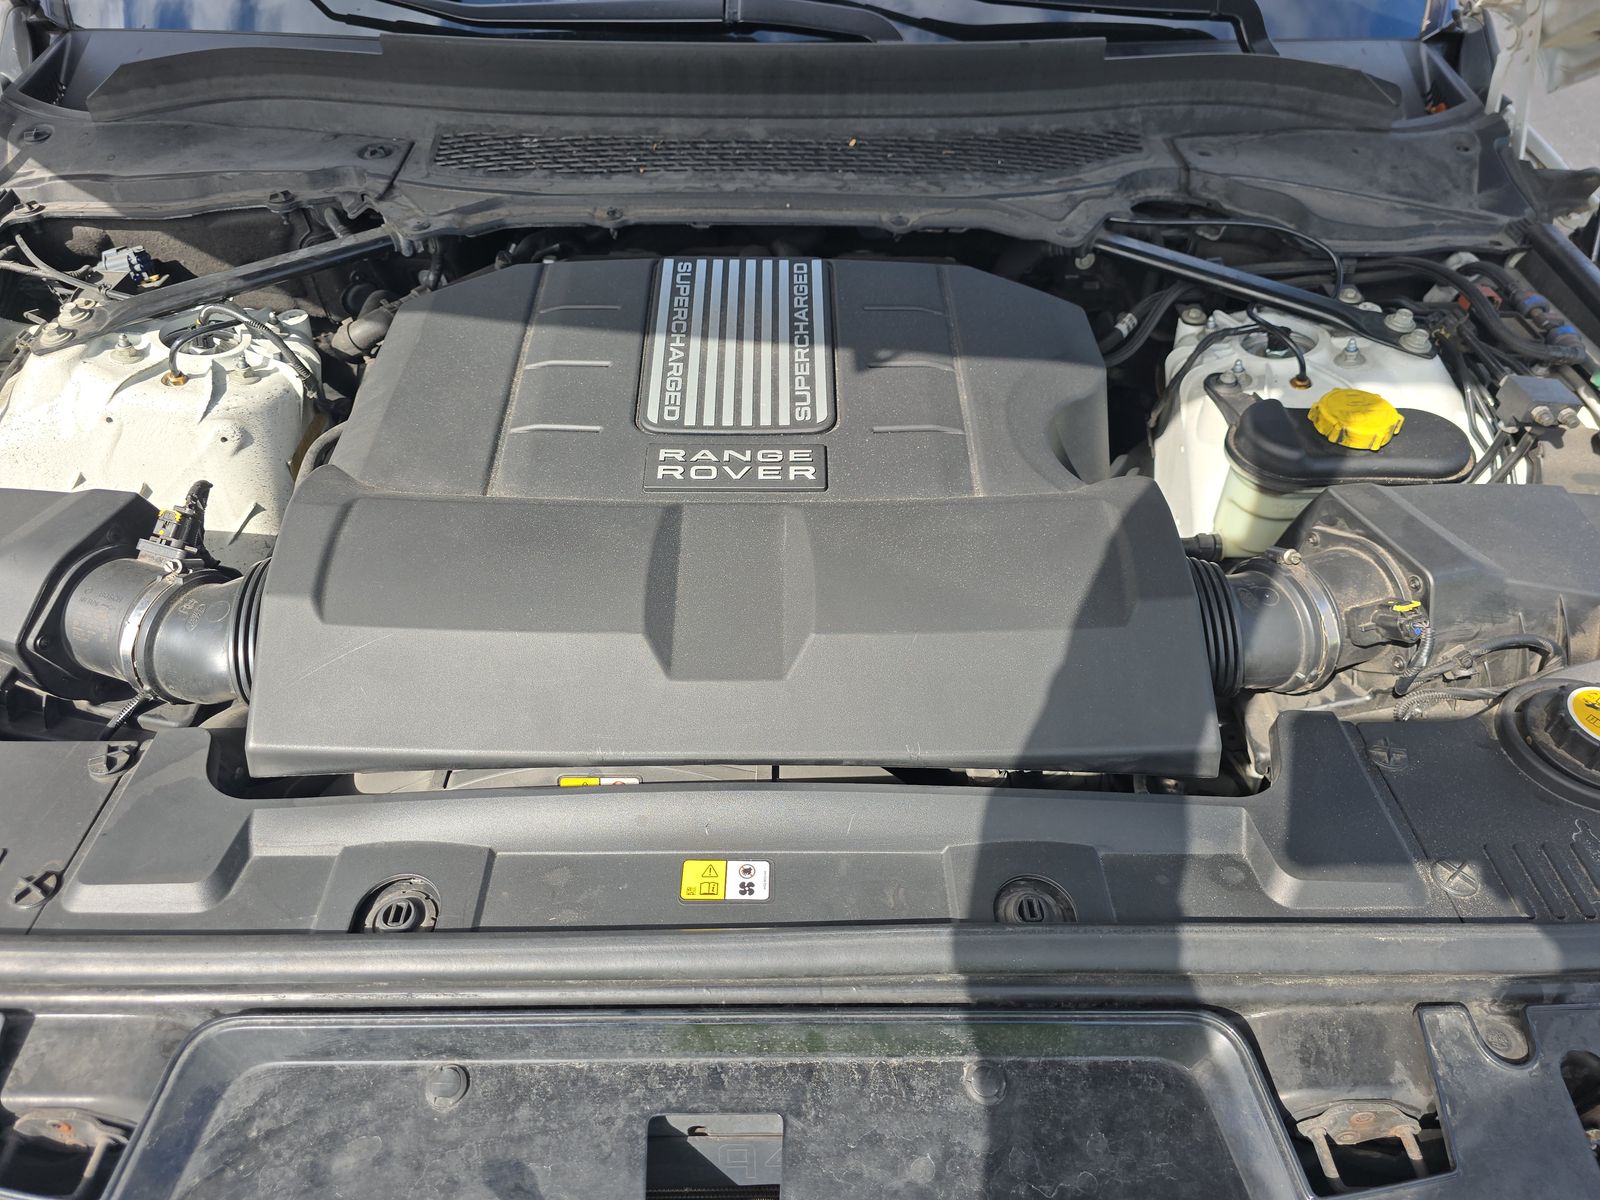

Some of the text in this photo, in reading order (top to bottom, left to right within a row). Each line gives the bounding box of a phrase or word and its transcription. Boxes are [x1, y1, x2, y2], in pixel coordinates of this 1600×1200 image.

[663, 262, 692, 421] SUPERCHARGED
[793, 262, 812, 422] SUPERCHARGED
[656, 465, 817, 480] ROVER
[658, 449, 814, 462] RANGE
